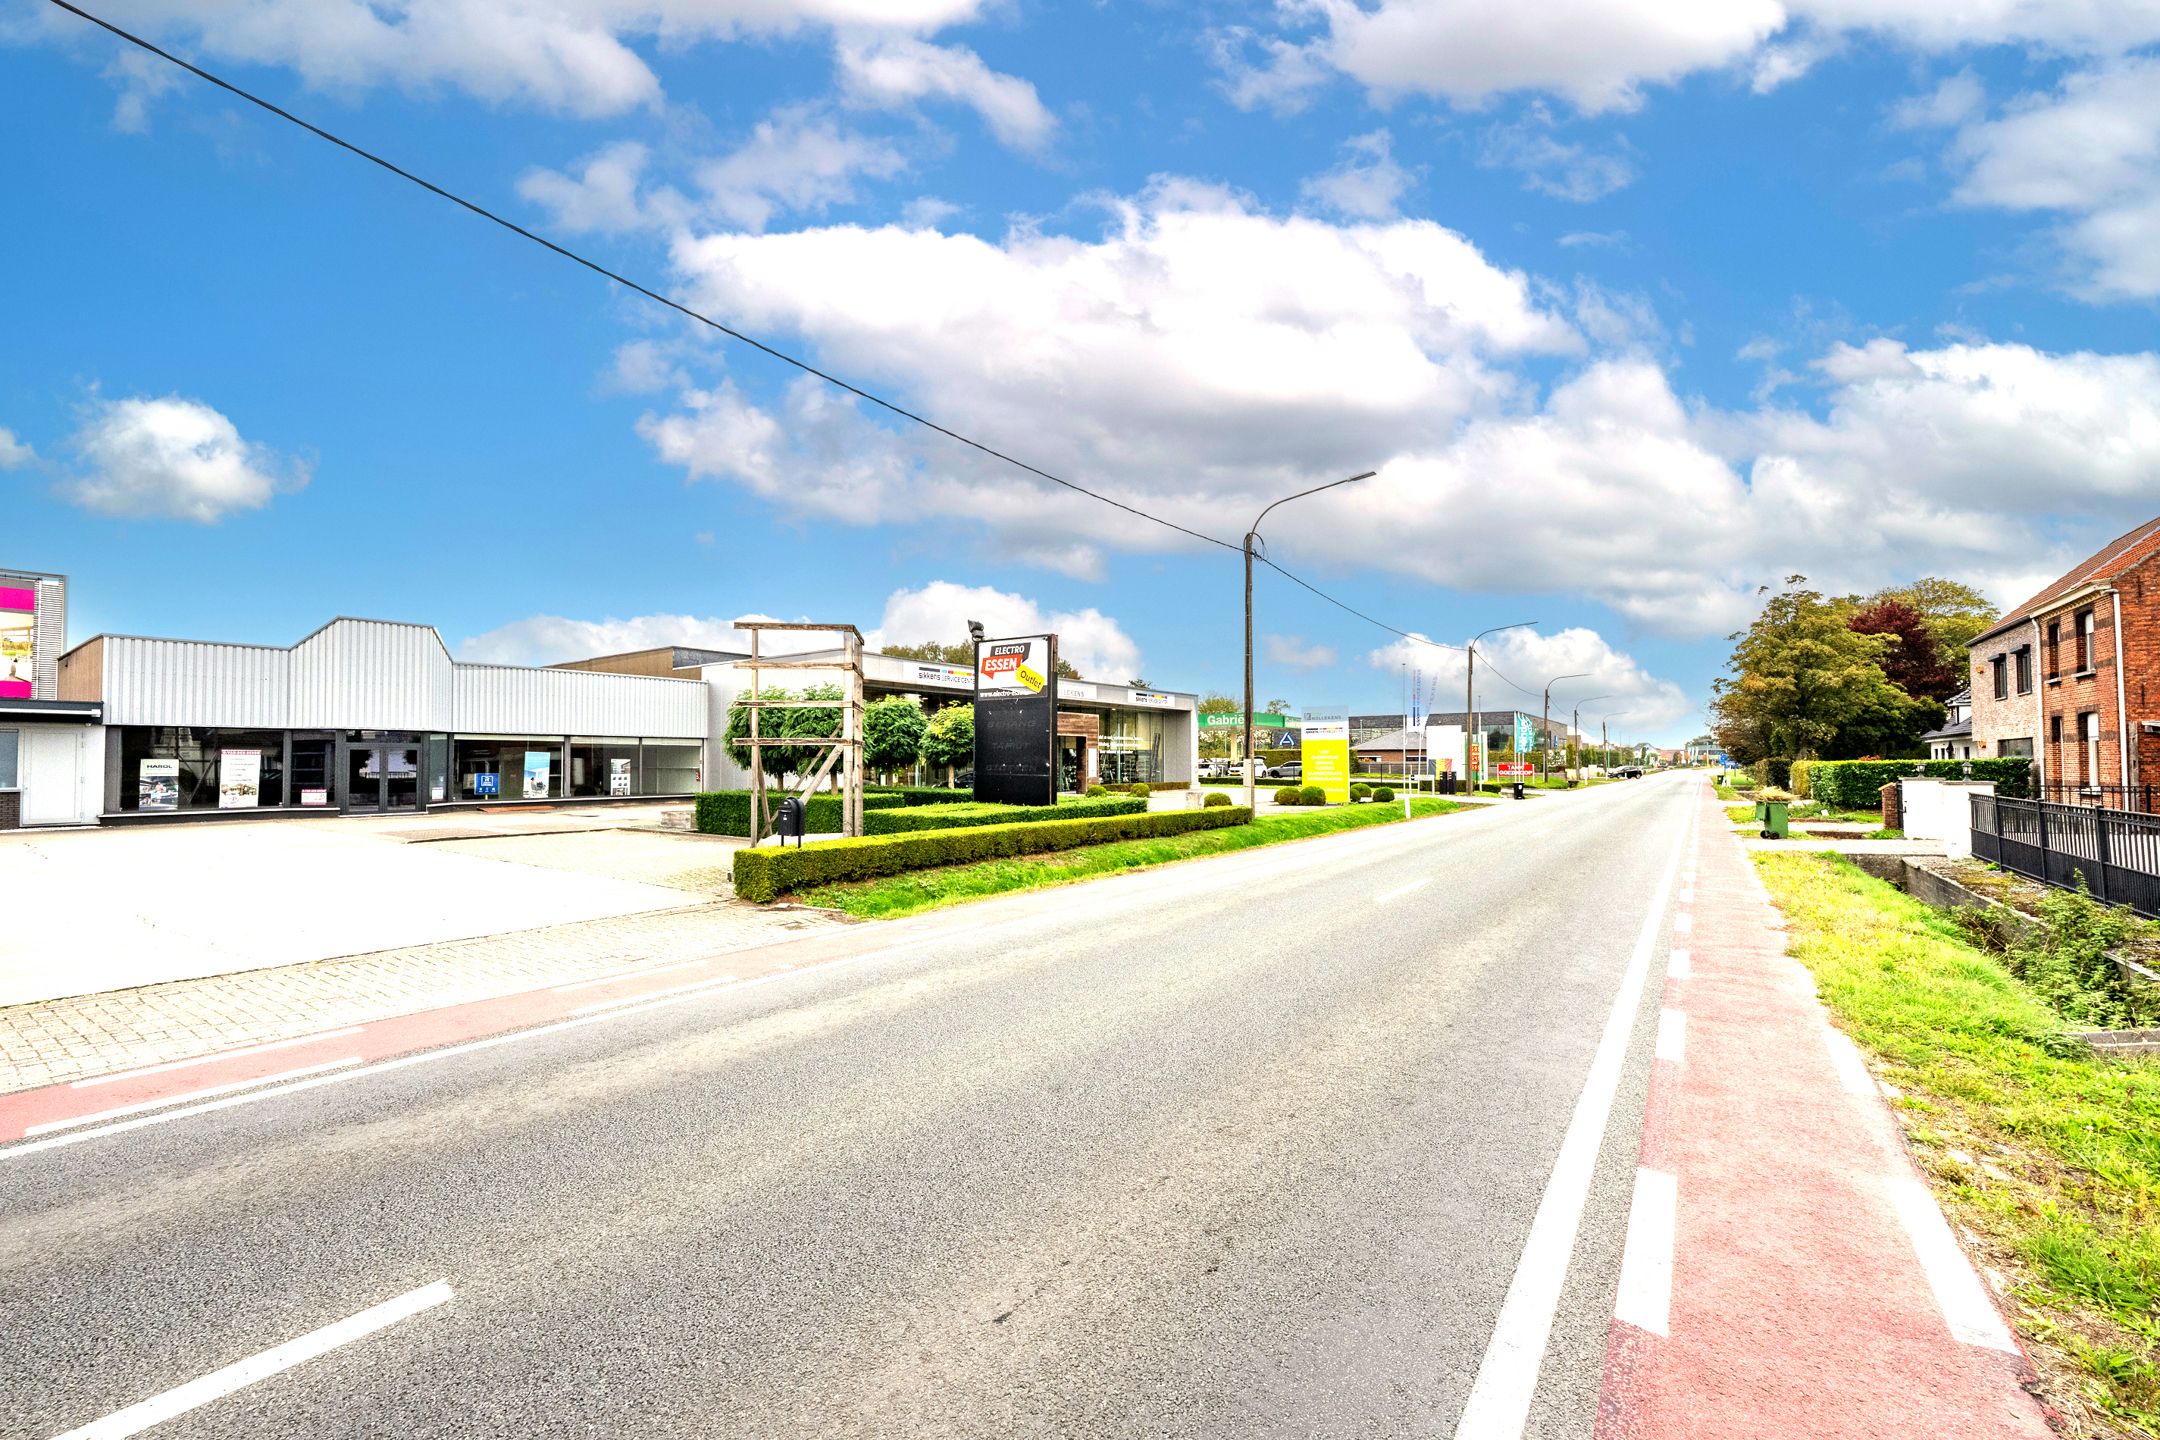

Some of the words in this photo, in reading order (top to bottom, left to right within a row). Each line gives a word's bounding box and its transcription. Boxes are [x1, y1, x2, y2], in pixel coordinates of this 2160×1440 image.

[994, 644, 1025, 655] ELECTRO
[984, 657, 1018, 671] ESSEN
[1020, 670, 1042, 689] Outlet
[1207, 714, 1245, 726] Gabrië
